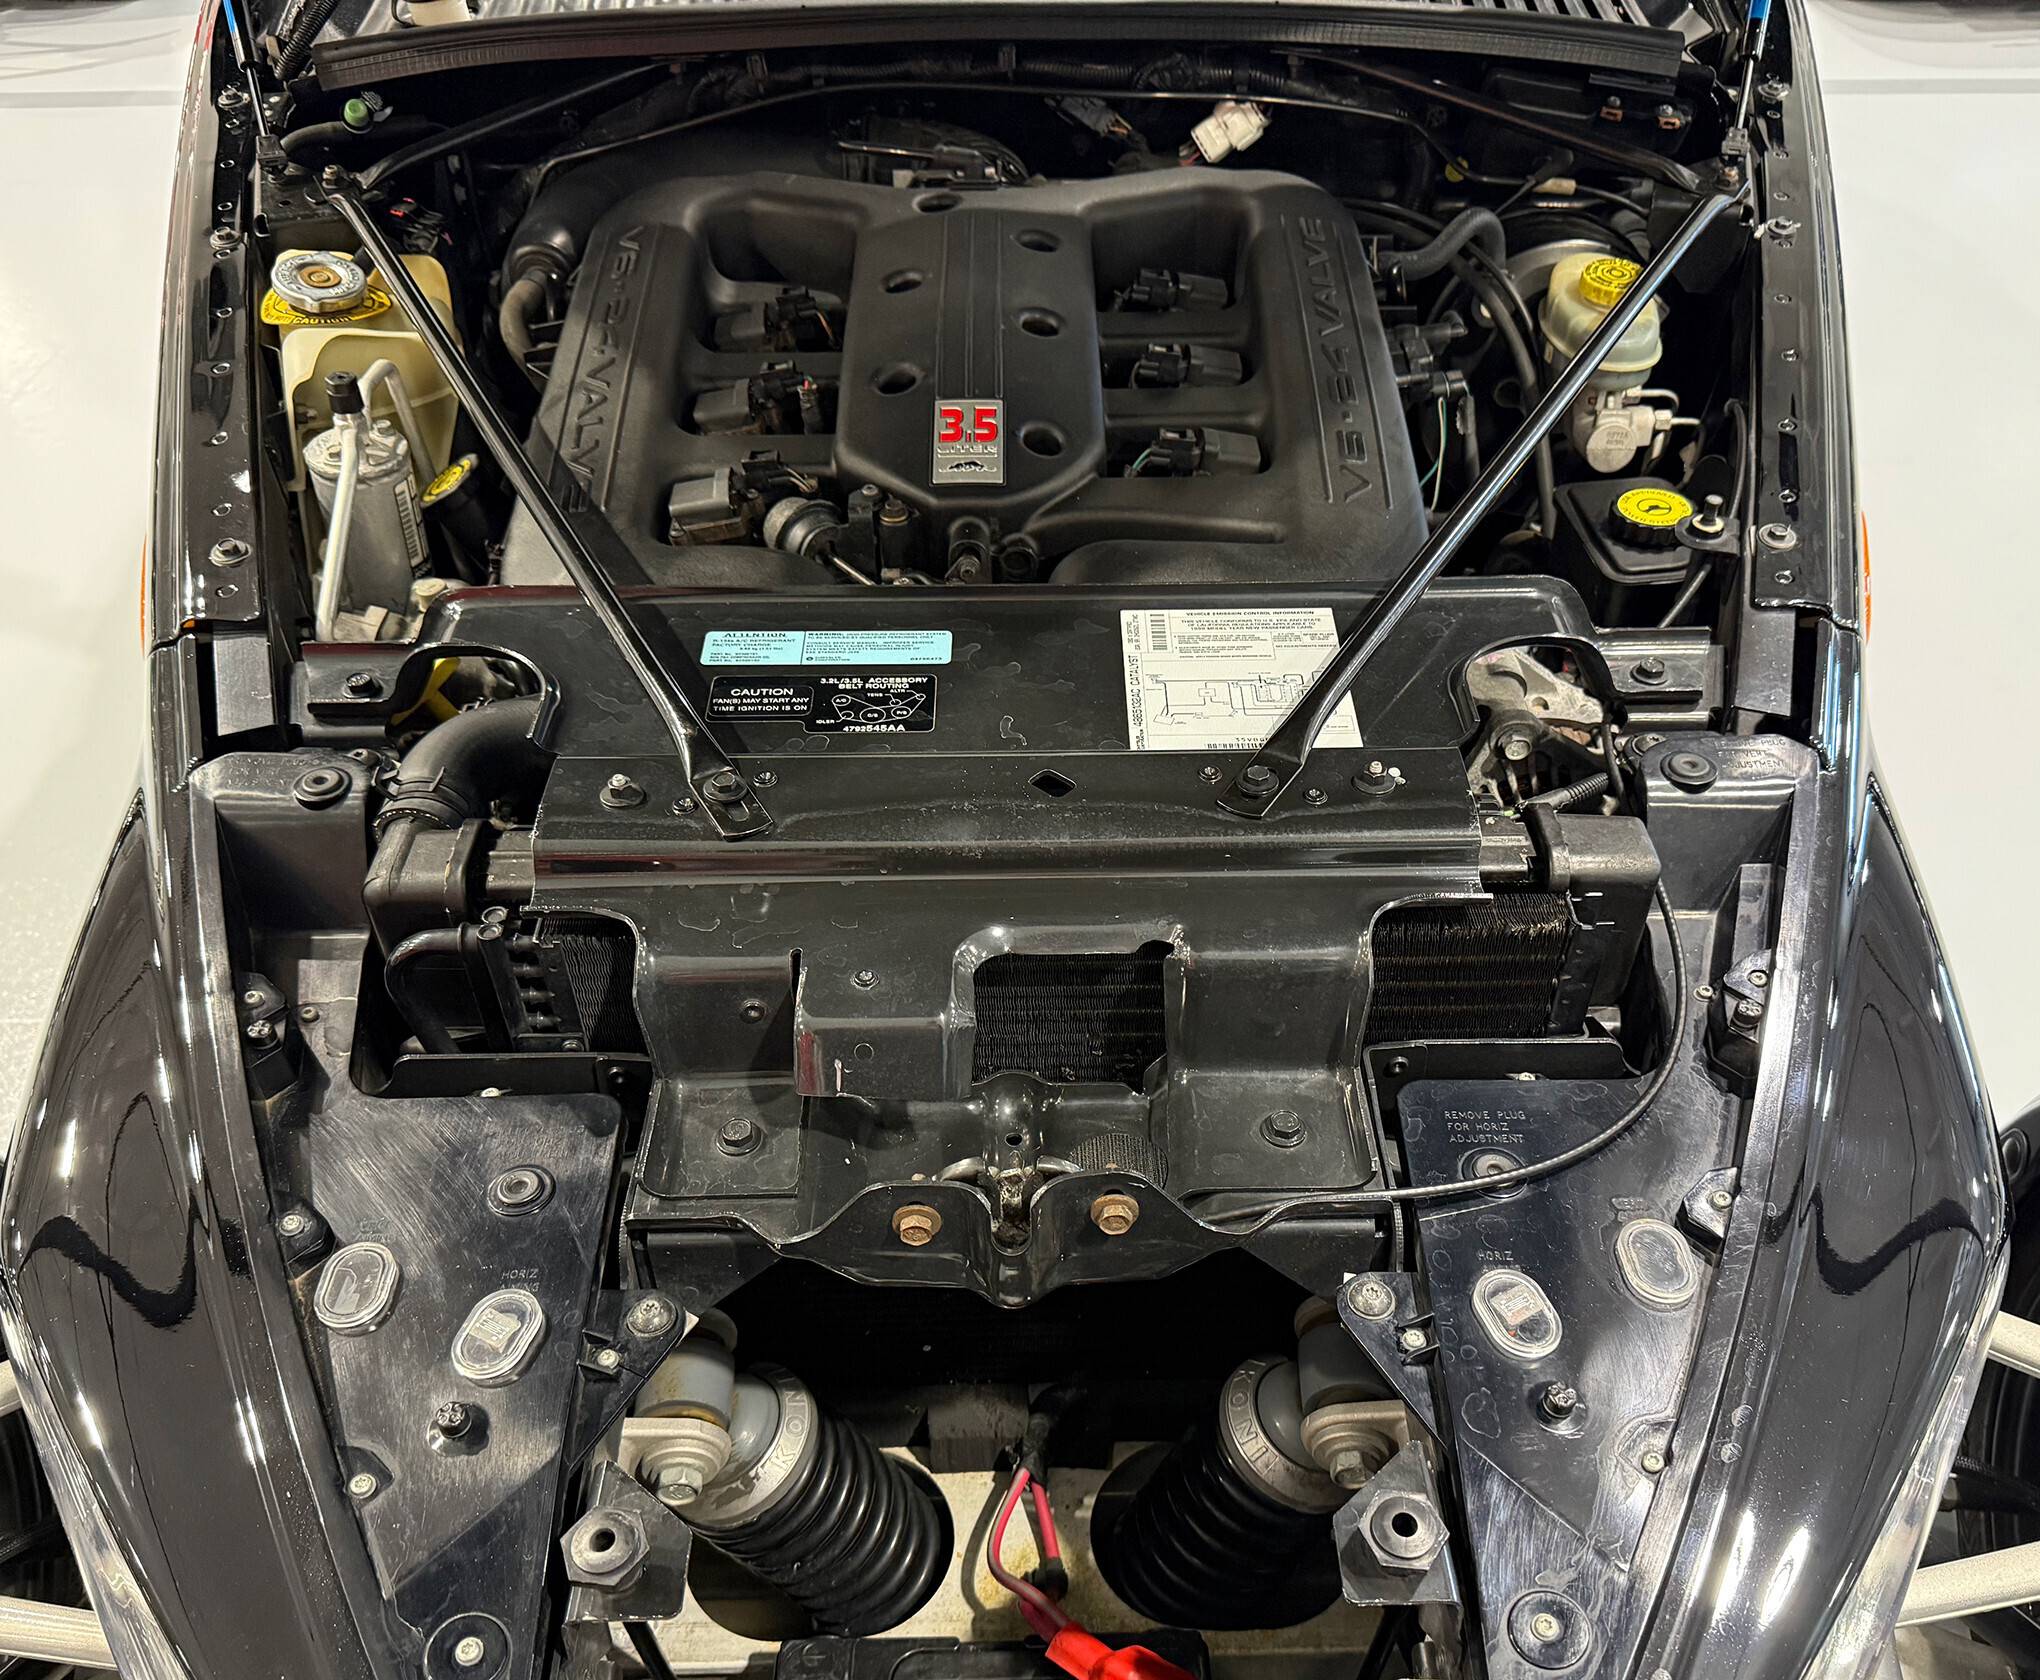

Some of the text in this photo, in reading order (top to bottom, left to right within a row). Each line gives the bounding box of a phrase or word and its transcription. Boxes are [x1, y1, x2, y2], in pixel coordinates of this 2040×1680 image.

[938, 406, 998, 443] 3.5
[937, 445, 997, 453] LITER
[1128, 655, 1140, 686] CATALYST
[730, 688, 794, 697] CAUTION
[1444, 1110, 1526, 1120] REMOVE PLUG
[1447, 1122, 1509, 1131] FOR HORIZ
[1449, 1134, 1525, 1143] ADJUSTMENT
[1478, 1249, 1515, 1261] HORIZ
[501, 1268, 539, 1280] HORIZ
[768, 1367, 807, 1472] KONI
